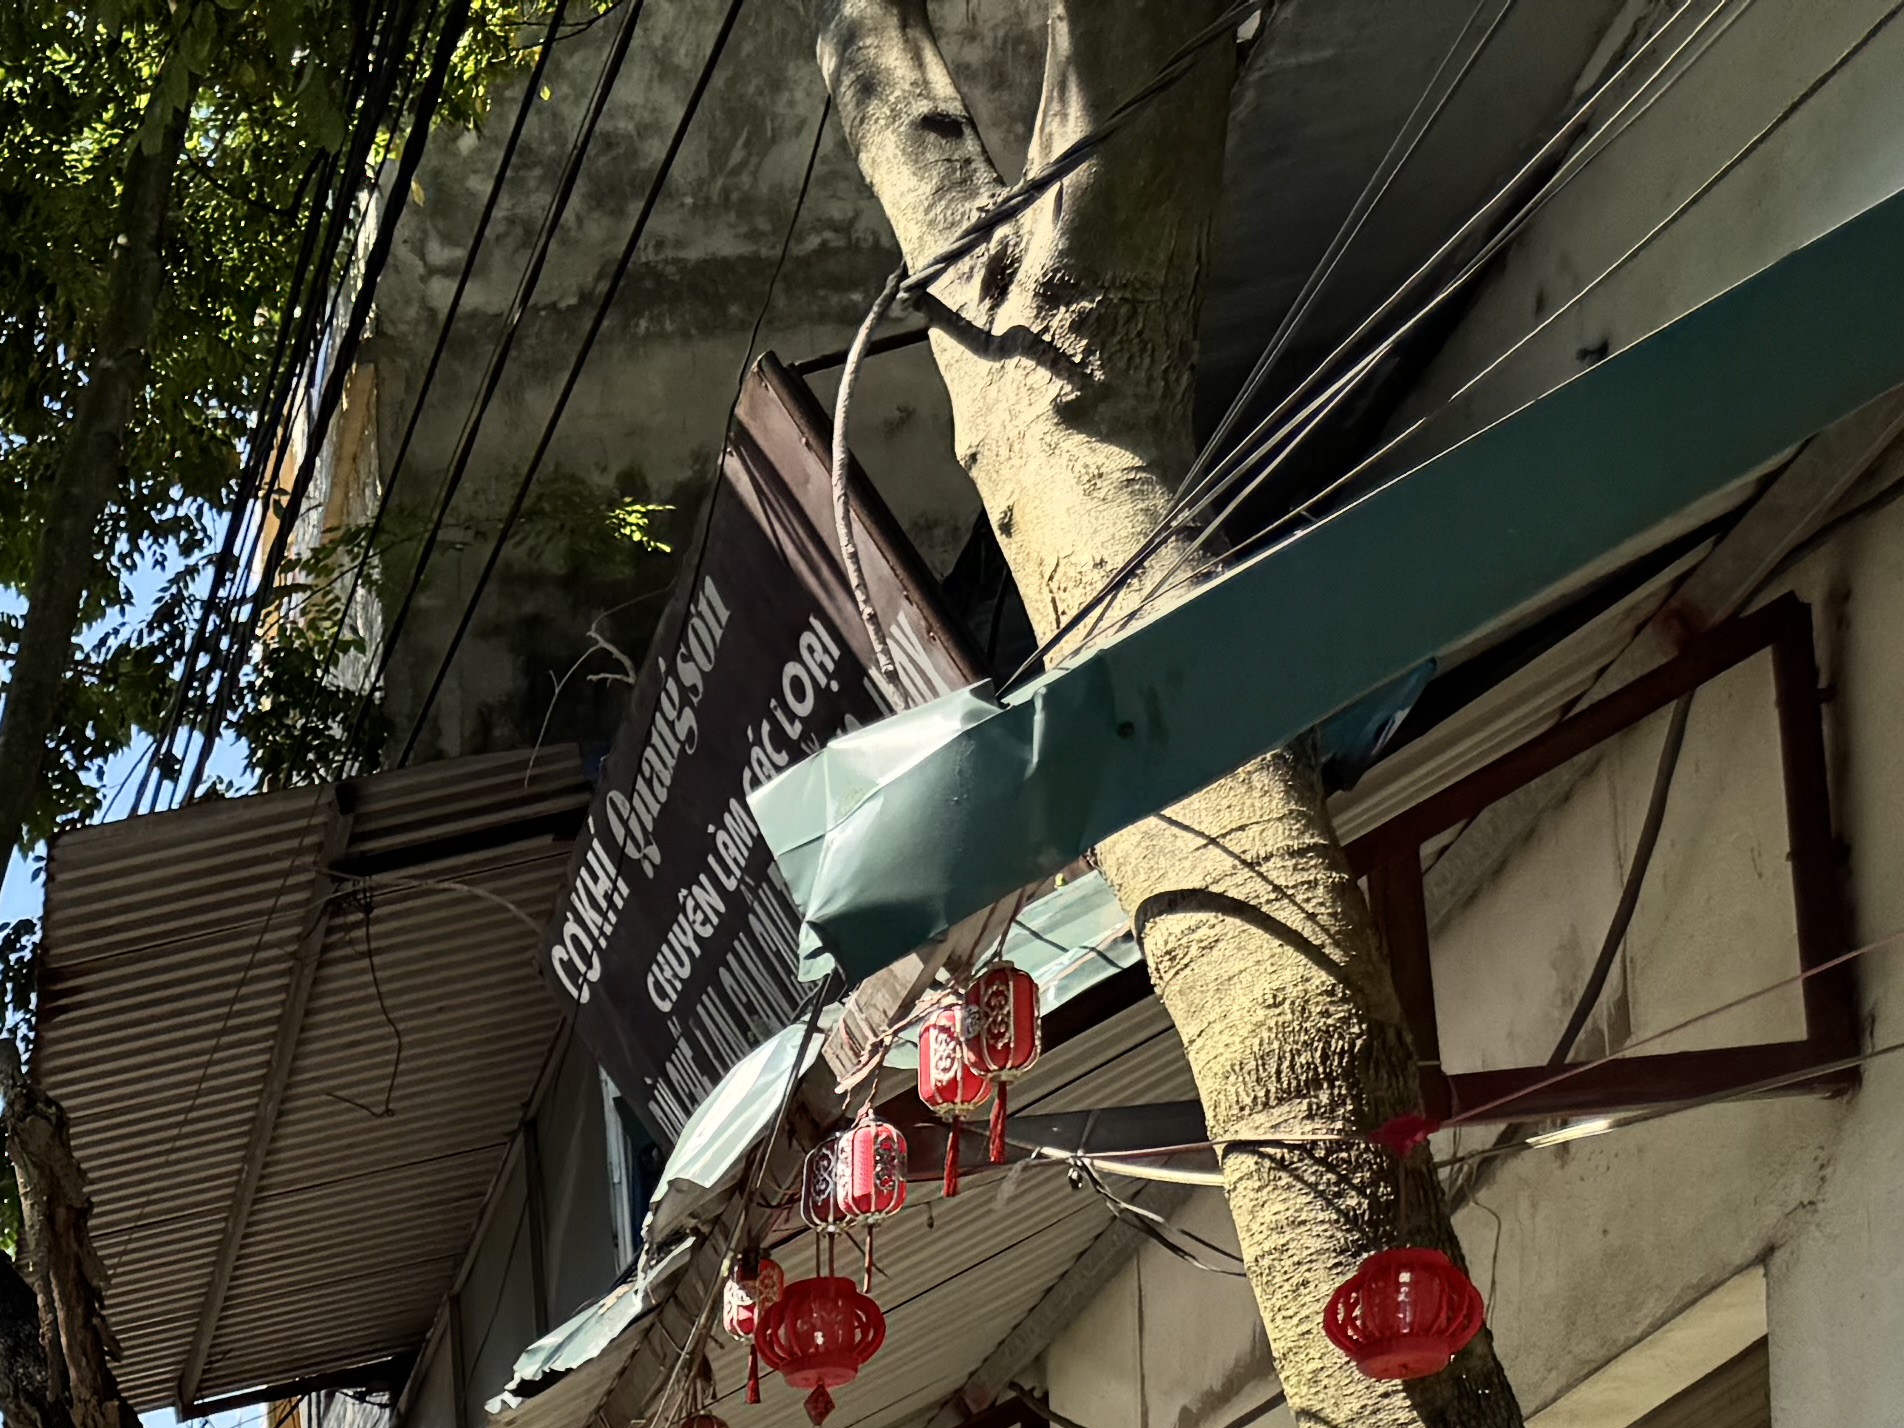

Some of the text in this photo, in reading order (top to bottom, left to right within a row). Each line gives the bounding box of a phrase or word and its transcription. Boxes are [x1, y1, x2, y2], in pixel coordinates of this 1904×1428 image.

[647, 873, 726, 1012] CHUYÊN
[707, 797, 758, 891] LÀM
[769, 612, 840, 740] LOẠI
[569, 815, 630, 949] KHÍ
[551, 911, 602, 1004] CƠ
